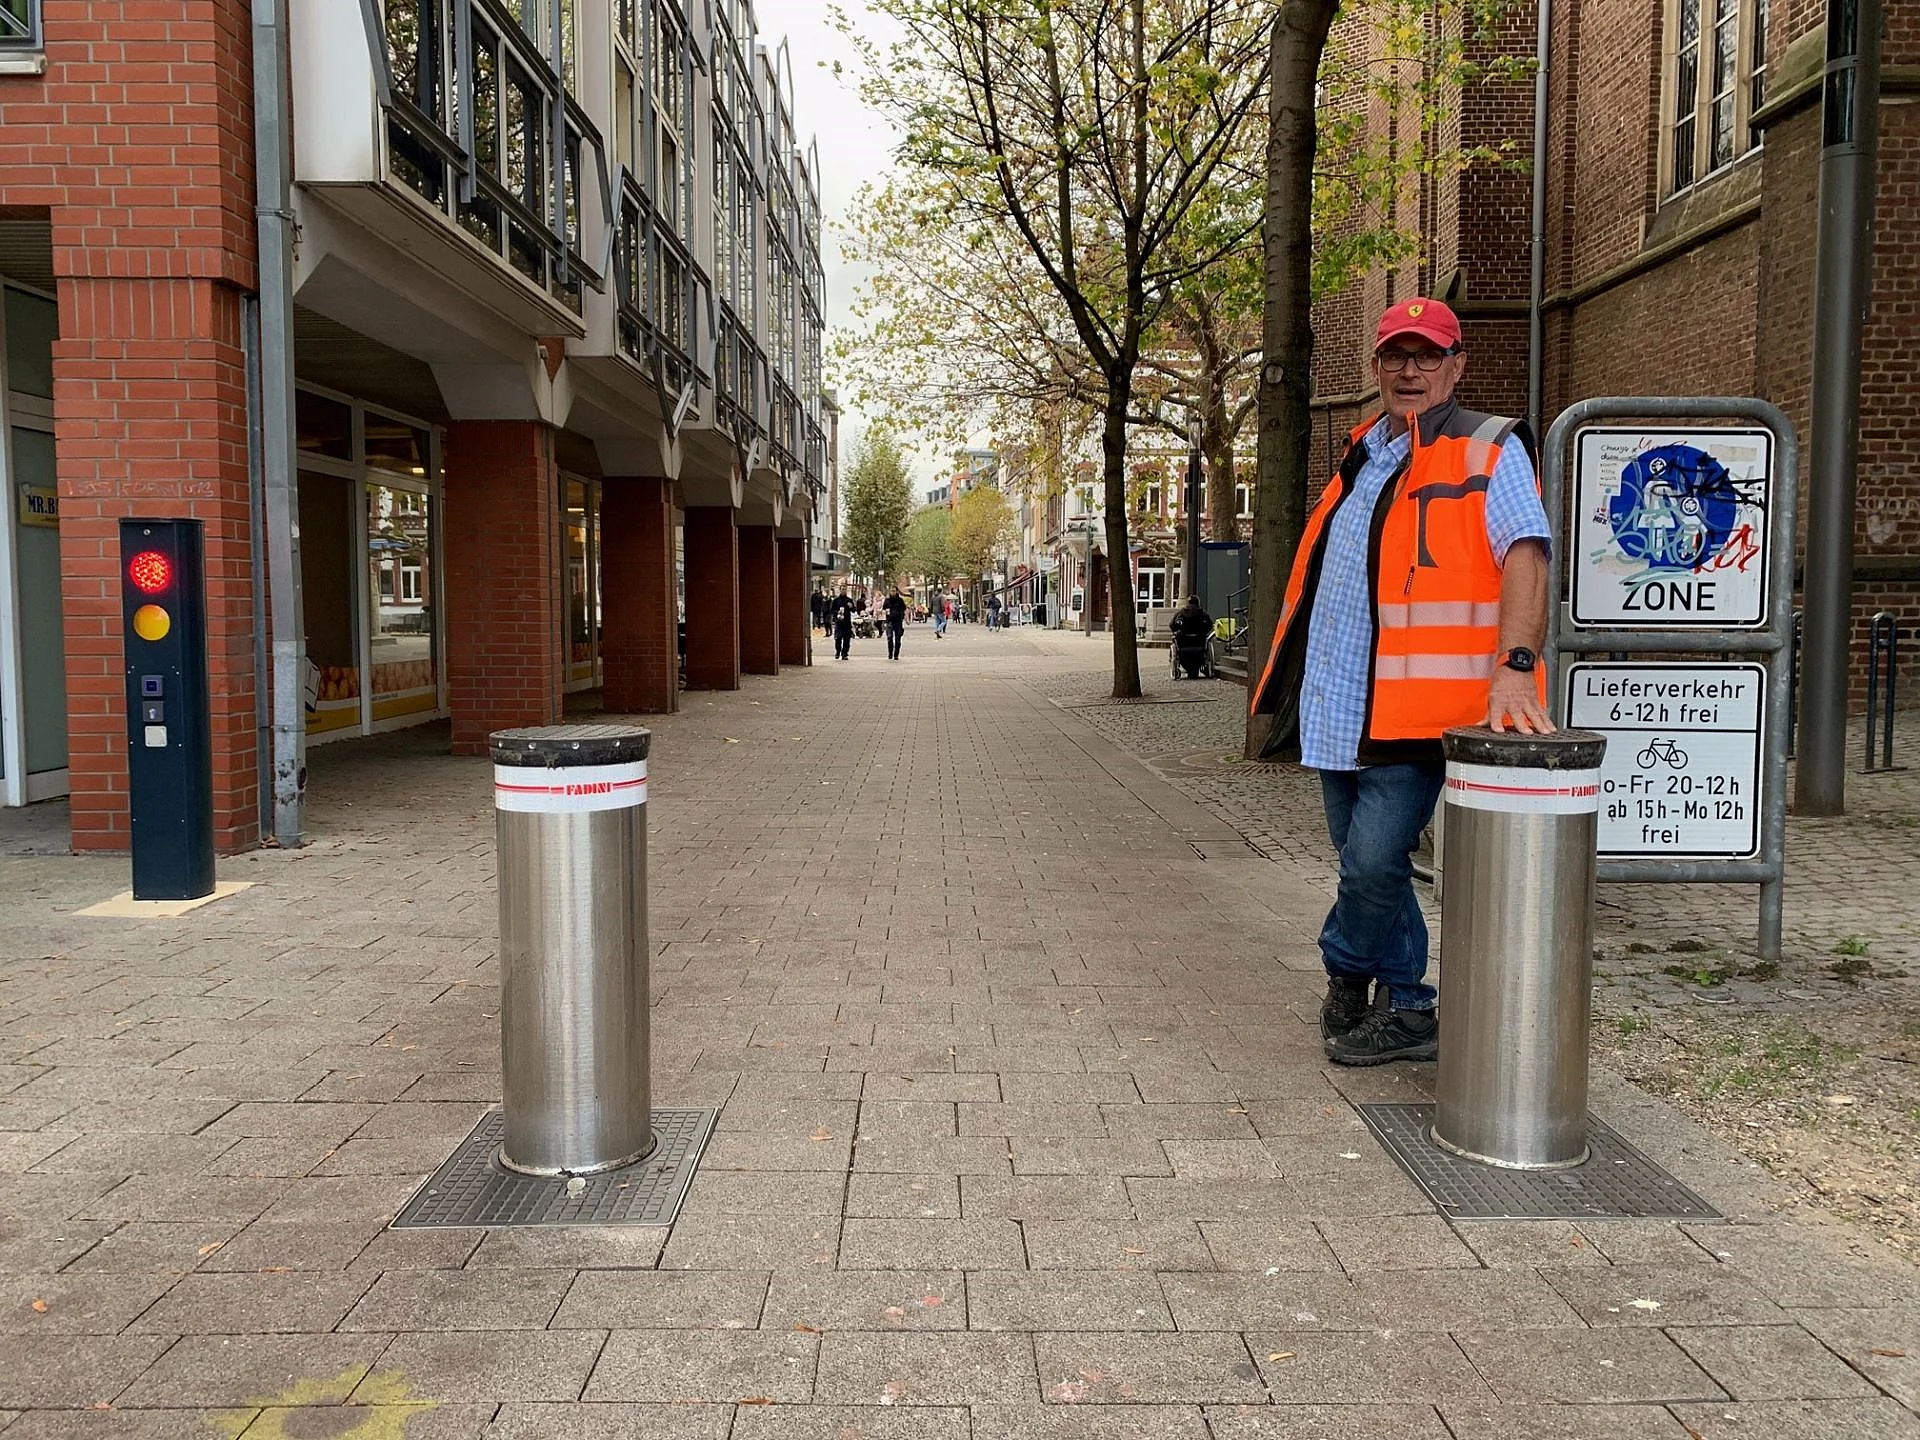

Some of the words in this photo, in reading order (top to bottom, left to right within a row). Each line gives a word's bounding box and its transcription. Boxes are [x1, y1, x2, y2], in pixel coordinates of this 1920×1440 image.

[1622, 582, 1716, 611] ZONE
[1586, 677, 1745, 699] Lieferverkehr
[1680, 704, 1718, 723] frei
[566, 782, 612, 796] FADINI
[1602, 775, 1654, 794] o-Fr
[1607, 804, 1627, 818] ab
[1716, 801, 1744, 820] 12h
[1642, 825, 1680, 844] frei
